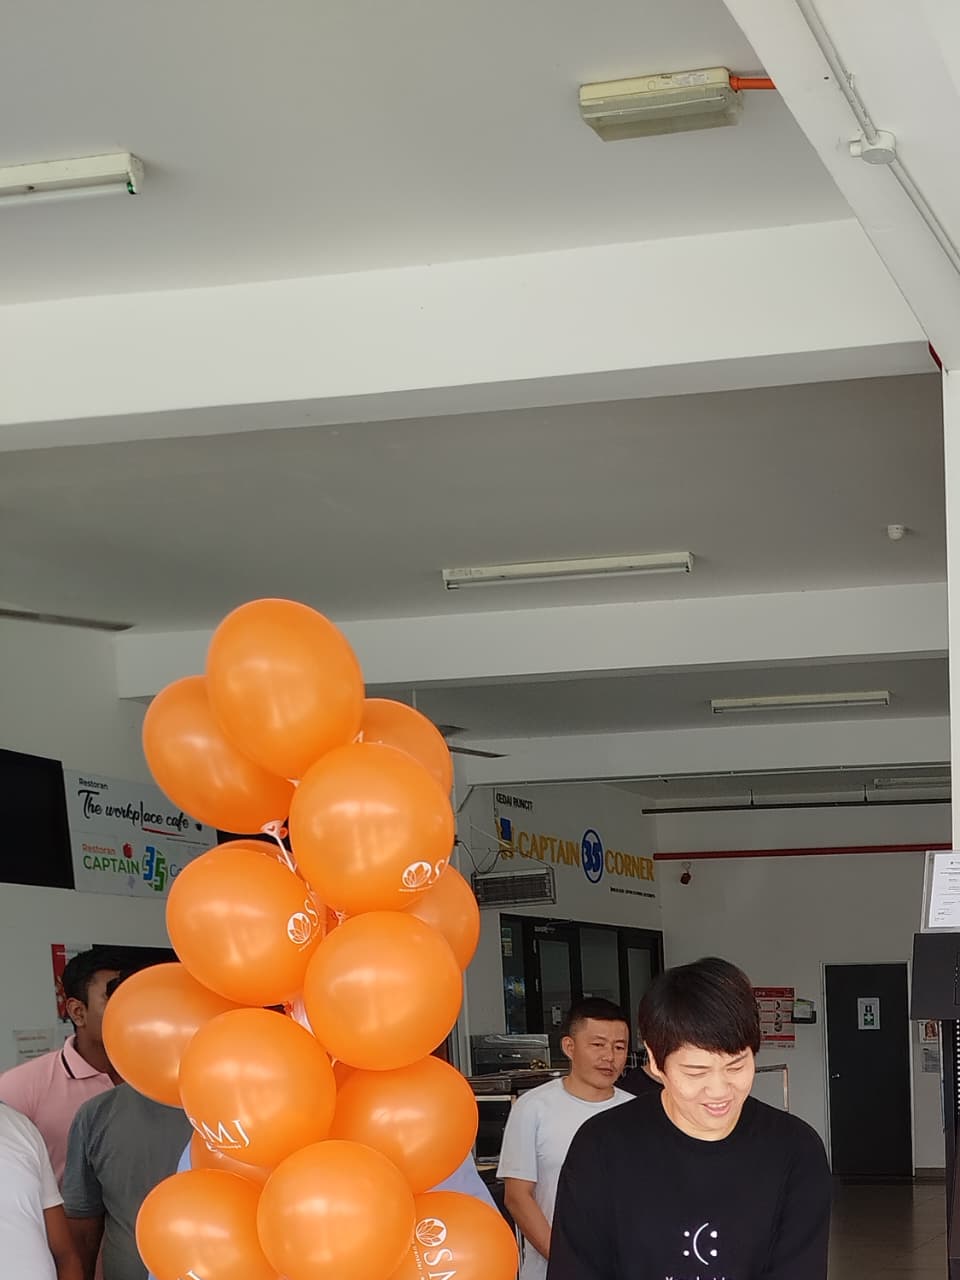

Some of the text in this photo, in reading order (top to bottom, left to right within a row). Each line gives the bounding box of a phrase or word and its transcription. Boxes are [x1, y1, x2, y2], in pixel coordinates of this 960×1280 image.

[78, 777, 109, 790] Restoran
[77, 789, 189, 831] The workplace cafe
[82, 843, 116, 855] Restoran
[83, 855, 140, 875] CAPTAIN
[142, 846, 168, 892] 35
[518, 831, 655, 881] CAPTAIN 35 CORNER
